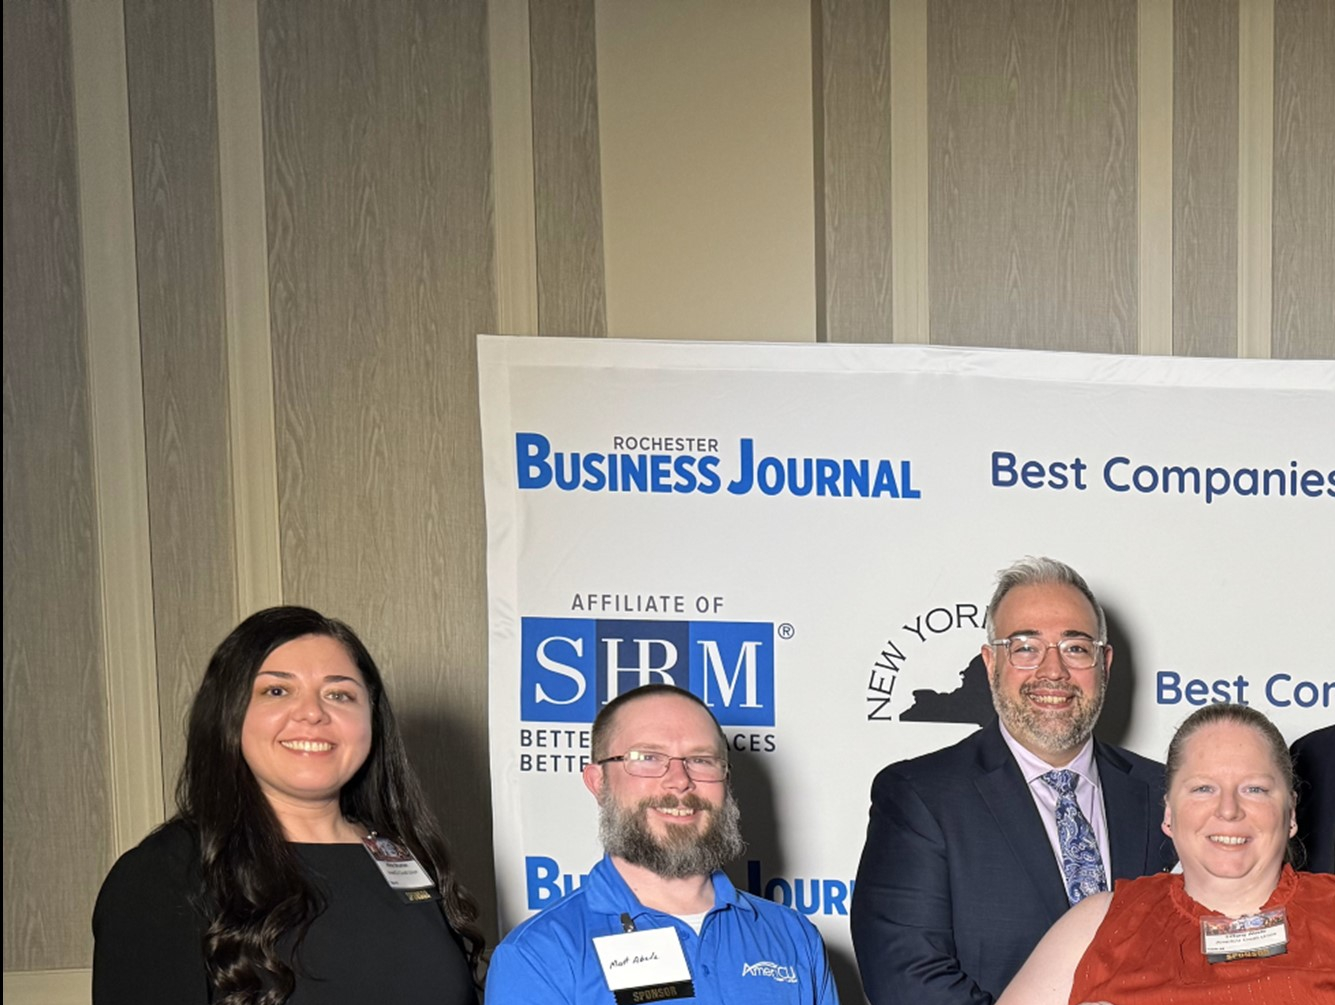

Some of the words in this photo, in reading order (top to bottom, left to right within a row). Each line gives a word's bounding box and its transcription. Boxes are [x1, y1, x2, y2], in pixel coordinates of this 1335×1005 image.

[613, 436, 719, 453] ROCHESTER
[515, 432, 721, 494] BUSINESS
[727, 438, 922, 499] JOURNAL
[990, 451, 1087, 490] Best
[571, 593, 685, 613] AFFILIATE
[696, 596, 725, 613] OF
[534, 636, 763, 709] SHRM
[867, 640, 907, 721] NEW
[1156, 671, 1249, 706] Best
[520, 729, 590, 748] BETTE
[520, 753, 591, 773] BETTE
[747, 860, 856, 916] JOUR
[632, 985, 678, 1002] SPONSOR
